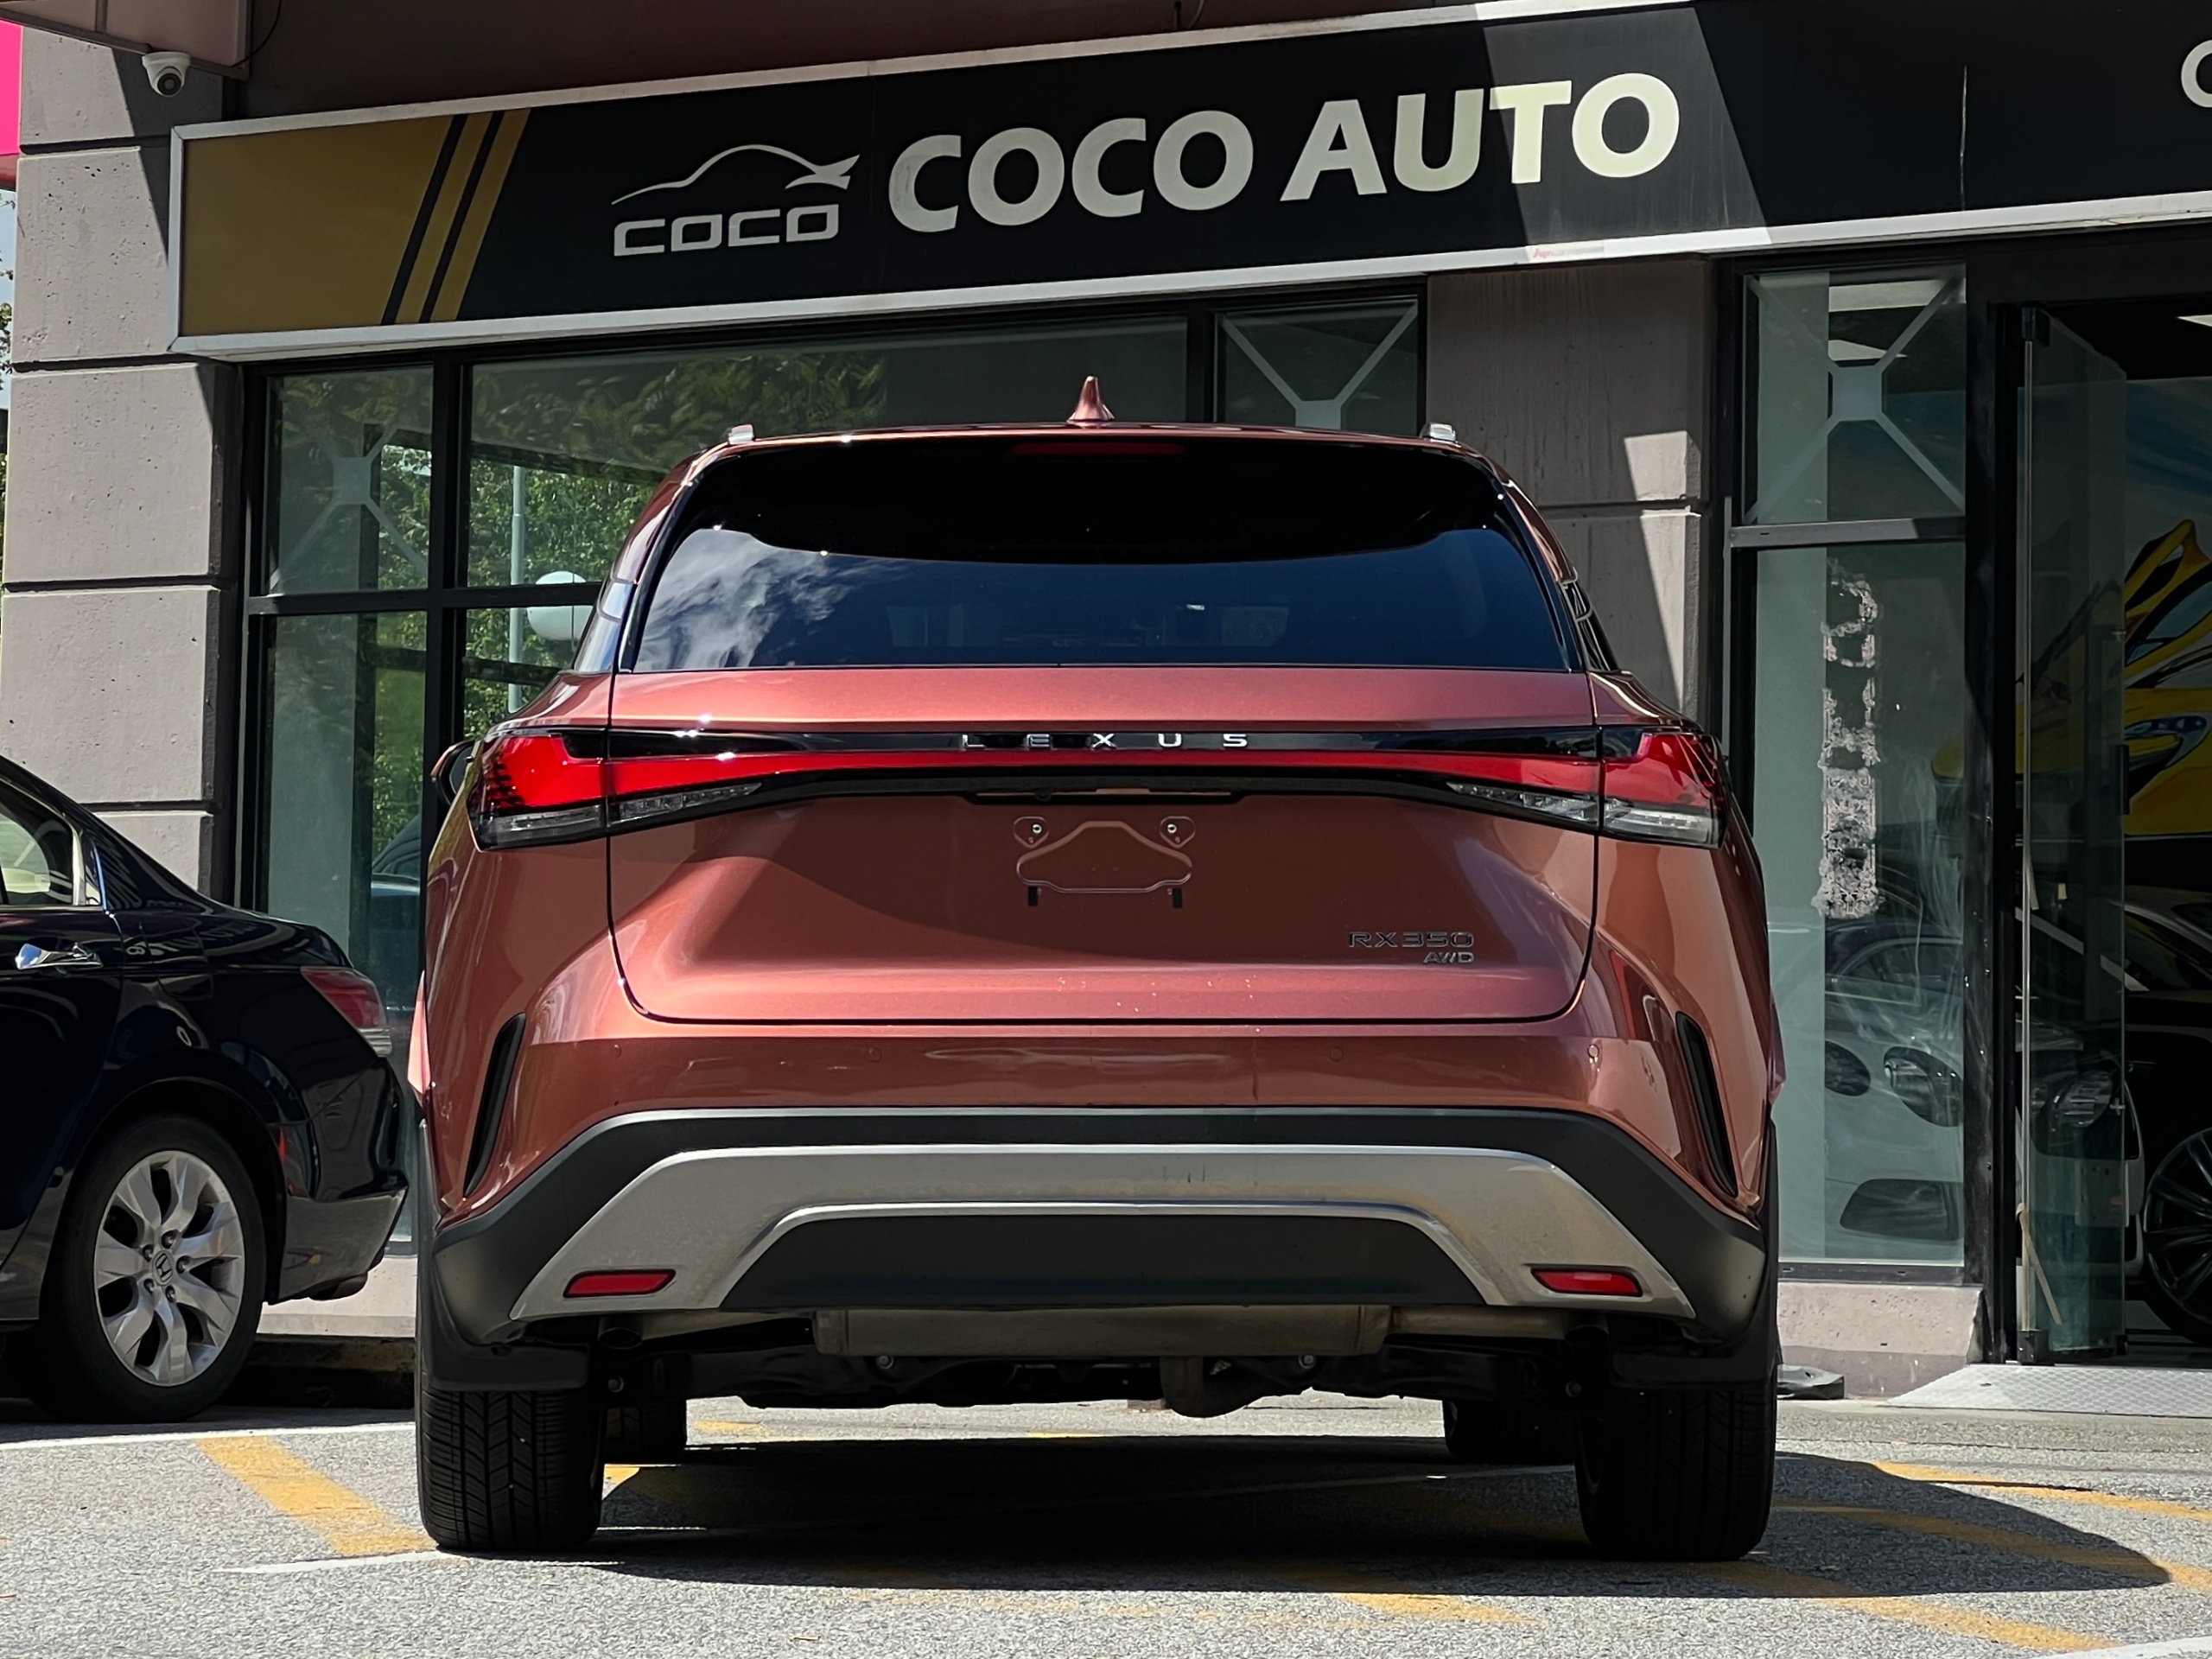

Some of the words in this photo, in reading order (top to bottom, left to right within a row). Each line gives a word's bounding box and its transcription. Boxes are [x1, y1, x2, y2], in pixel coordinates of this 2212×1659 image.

[889, 111, 1254, 232] COCO
[1280, 73, 1680, 201] AUTO
[613, 204, 839, 257] COCO
[961, 733, 1249, 748] LEXUS
[1422, 951, 1475, 964] AWD
